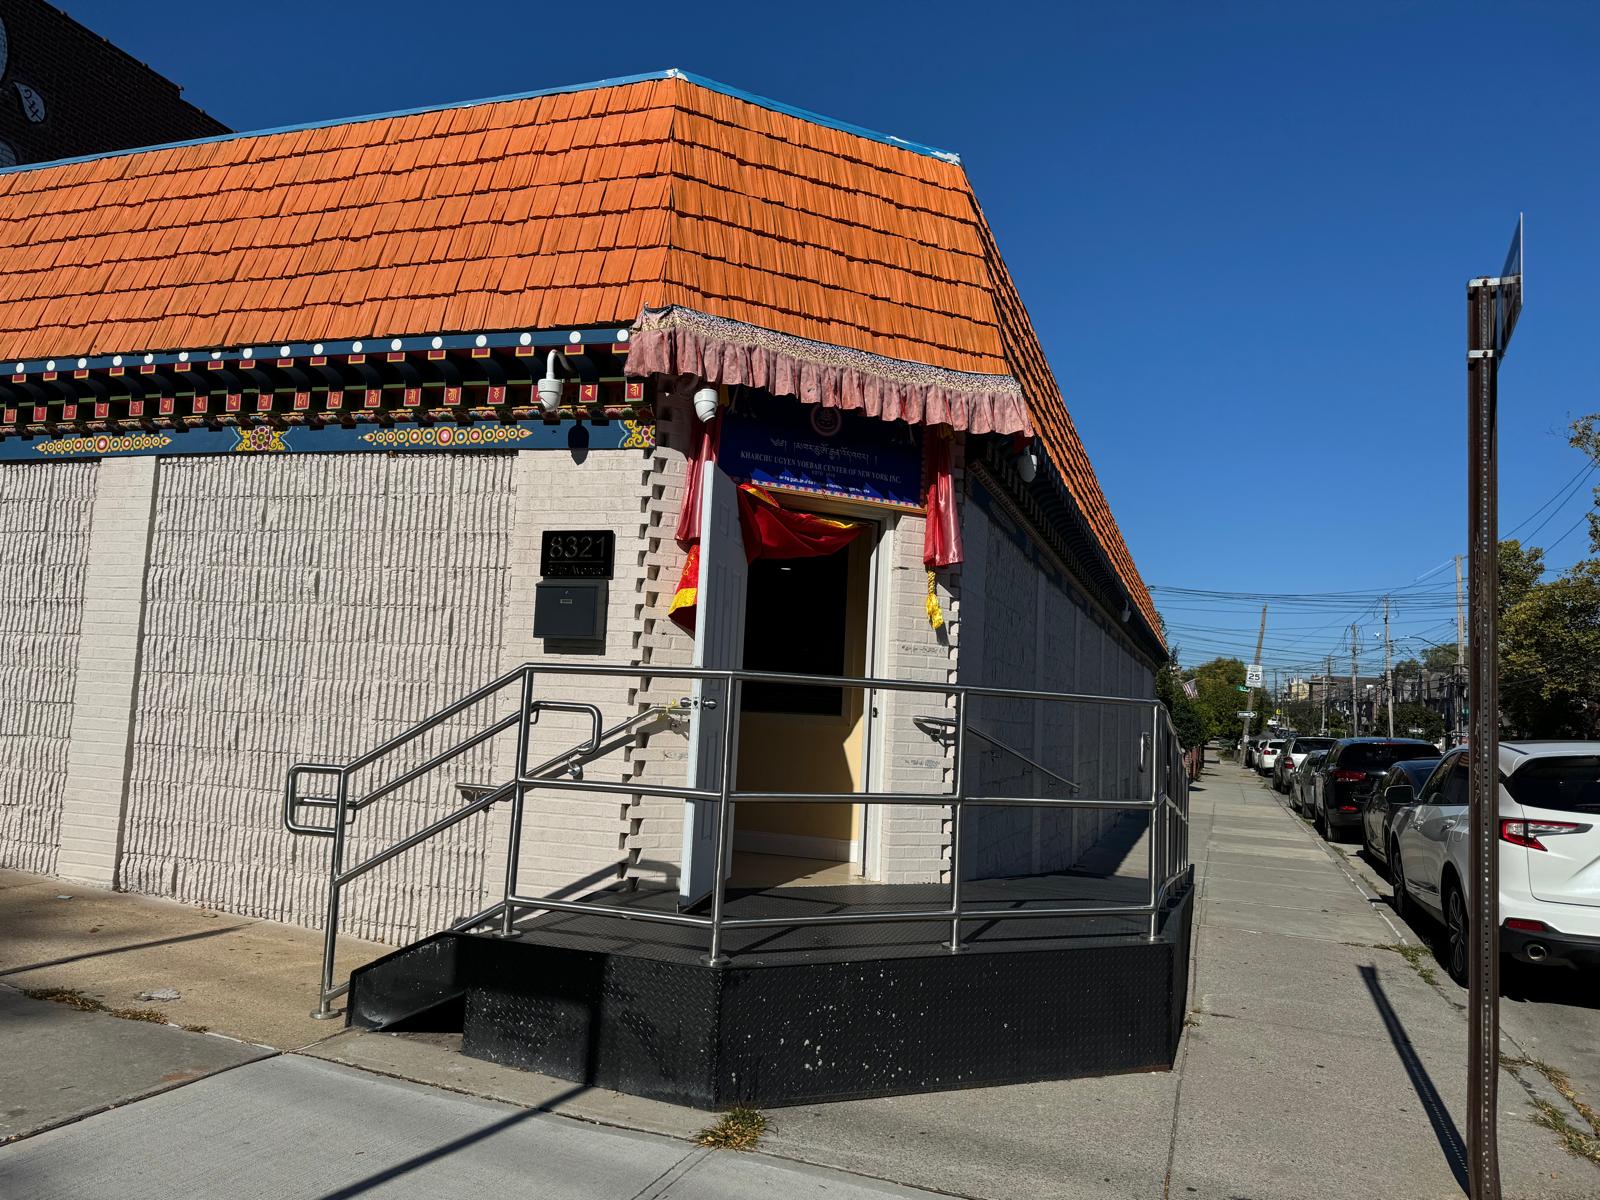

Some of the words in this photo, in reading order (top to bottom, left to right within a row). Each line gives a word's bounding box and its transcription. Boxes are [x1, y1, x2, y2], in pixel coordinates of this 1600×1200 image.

[740, 450, 773, 462] KHARCHU
[774, 455, 796, 465] UGYEN
[823, 464, 848, 475] CENTER
[848, 468, 857, 476] OF
[857, 468, 872, 479] NEW
[872, 472, 889, 481] YORK
[549, 536, 605, 558] 8321
